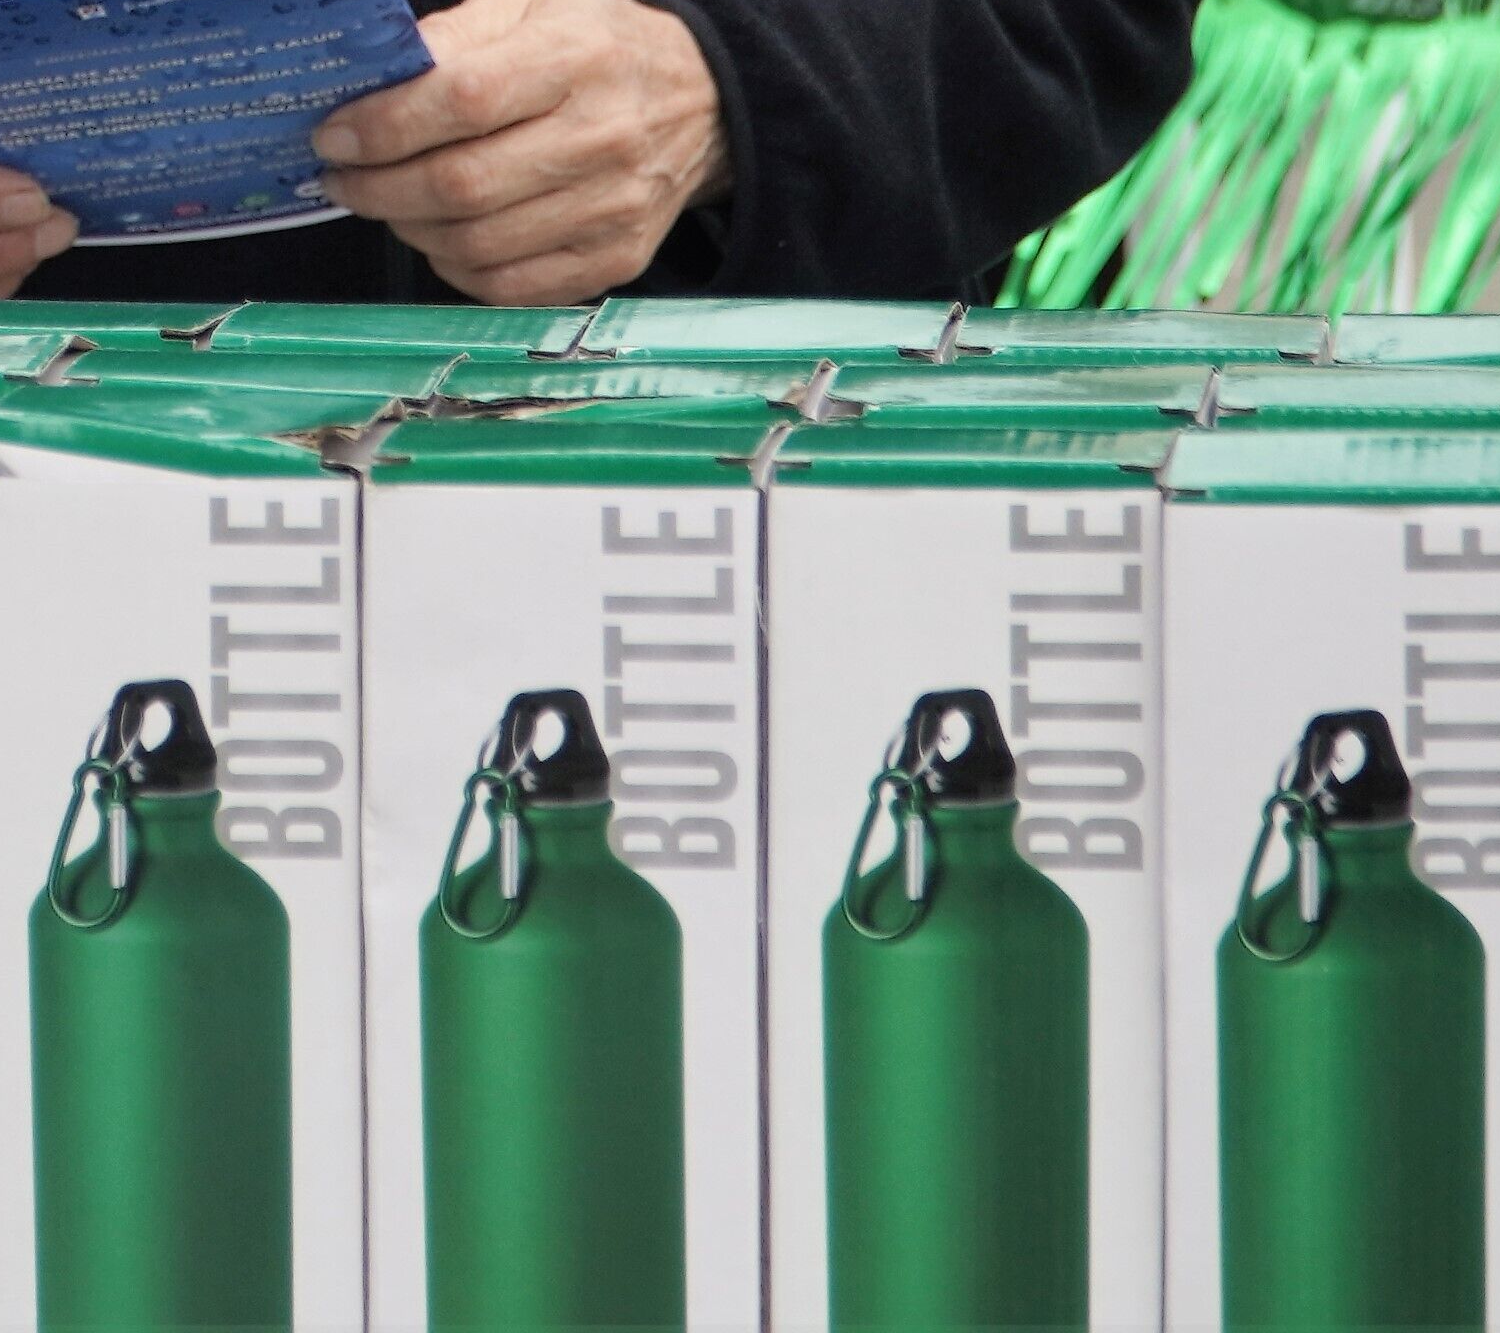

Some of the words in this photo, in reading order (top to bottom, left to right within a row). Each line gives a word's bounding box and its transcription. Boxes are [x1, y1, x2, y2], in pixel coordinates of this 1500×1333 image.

[209, 495, 343, 859] BOTTLE
[601, 505, 738, 871] BOTTLE
[1008, 503, 1144, 872] BOTTLE
